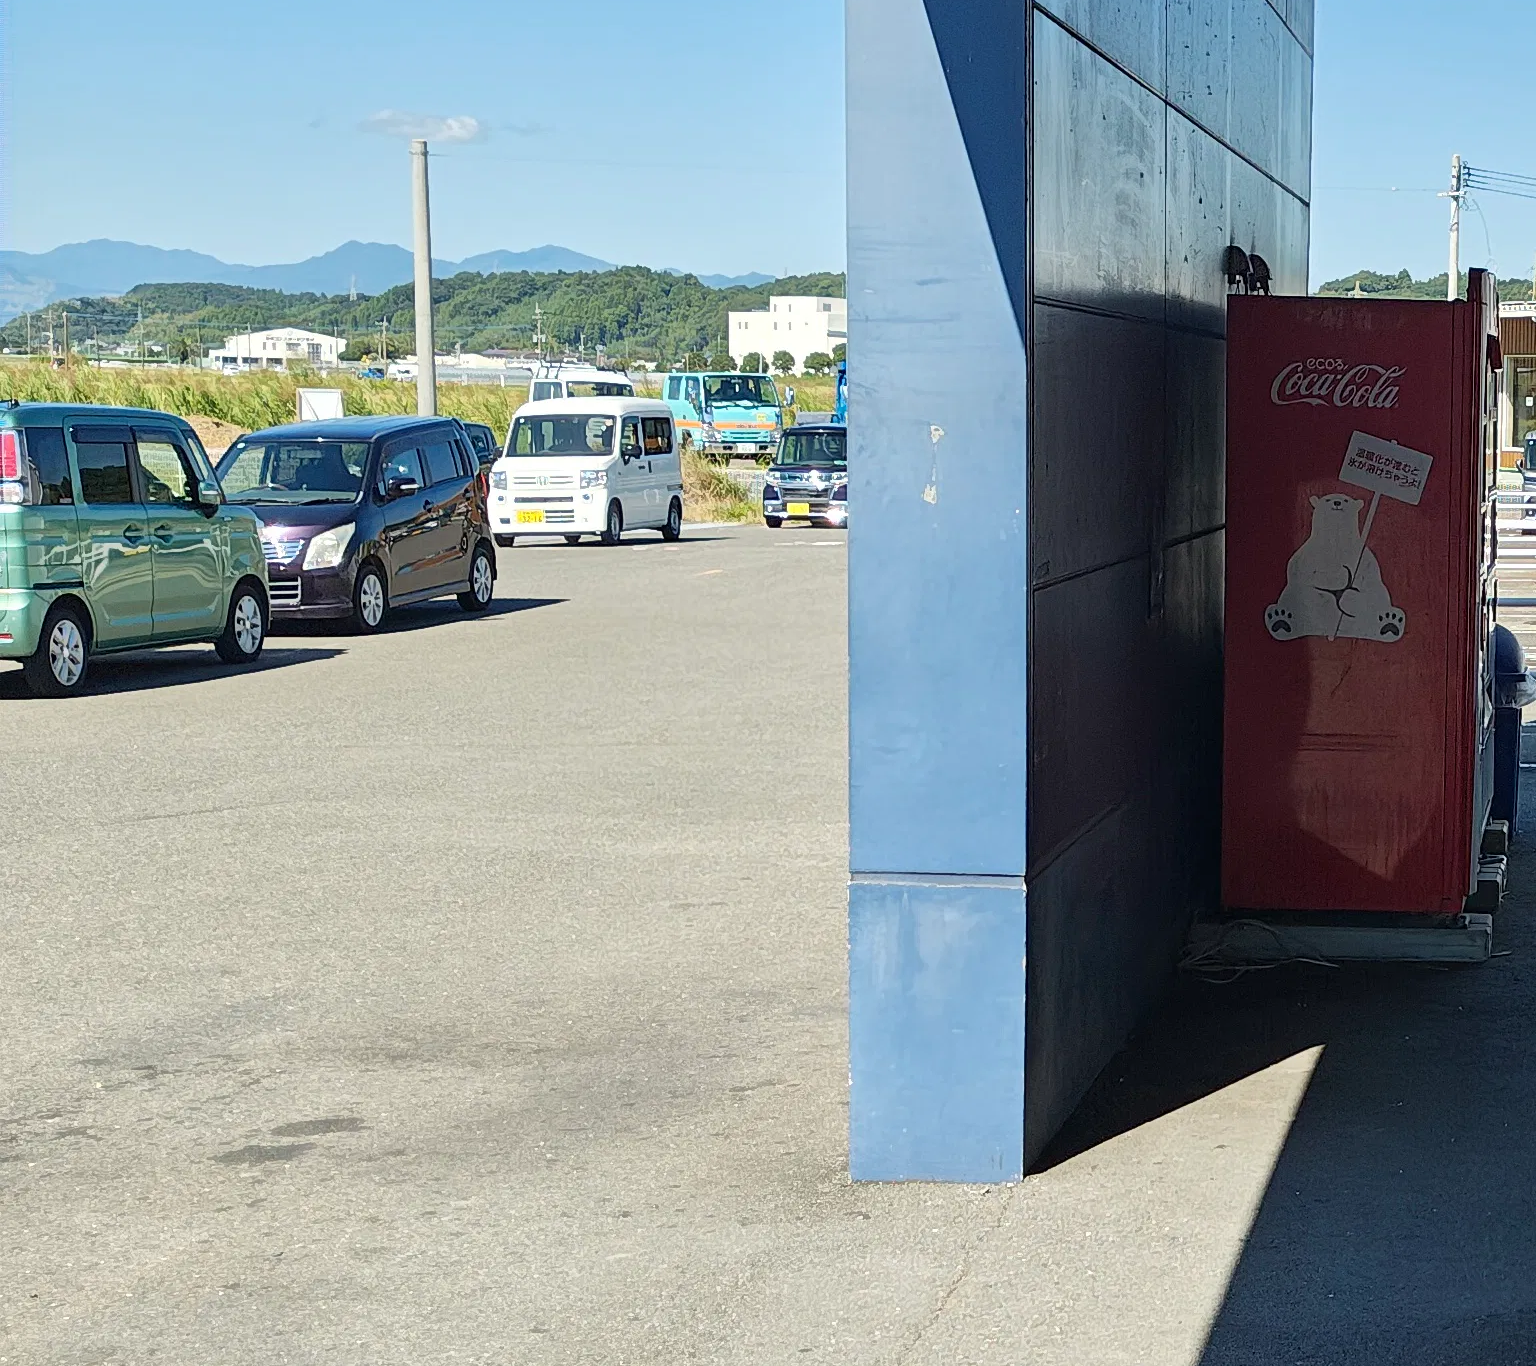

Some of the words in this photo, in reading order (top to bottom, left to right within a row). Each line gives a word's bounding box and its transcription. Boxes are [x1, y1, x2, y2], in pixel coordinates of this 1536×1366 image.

[1270, 362, 1407, 408] Coca-Cola
[1356, 447, 1421, 476] 温暖化が進むと
